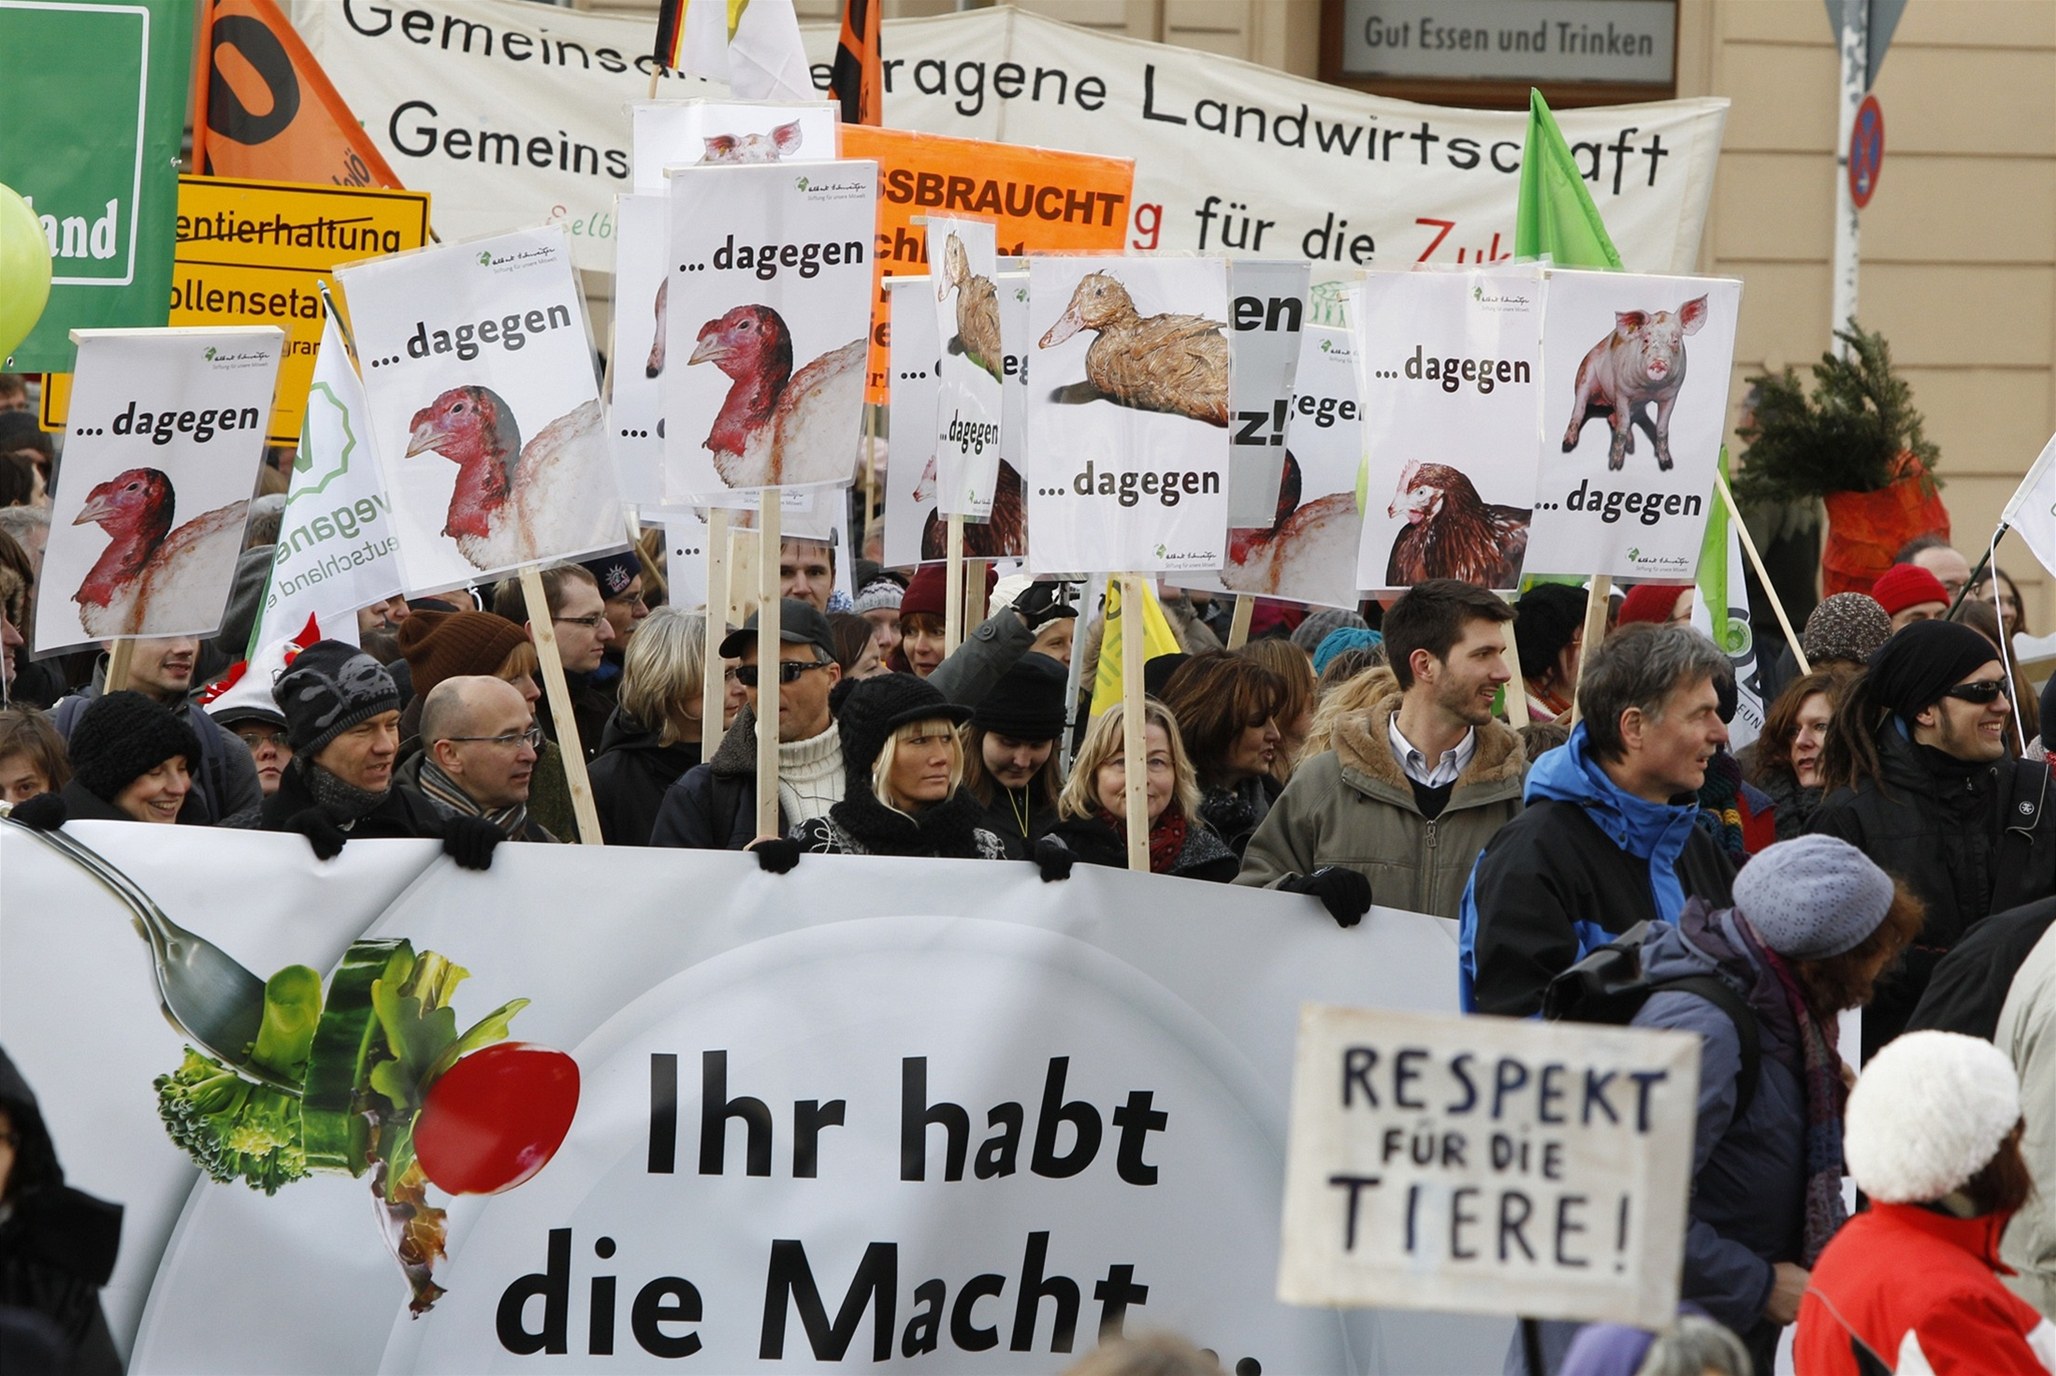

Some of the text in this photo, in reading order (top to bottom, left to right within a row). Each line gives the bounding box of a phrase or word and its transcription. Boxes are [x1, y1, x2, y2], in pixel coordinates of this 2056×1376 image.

[1364, 16, 1654, 56] Gut Essen und Trinken
[343, 0, 1669, 195] Gemeinsa eragene Landwirtscaft
[23, 196, 118, 259] and
[176, 210, 400, 253] entierhaltung
[1132, 203, 1163, 250] g
[1195, 196, 1276, 252] für
[1302, 212, 1375, 265] die
[713, 235, 864, 280] dagegen
[408, 306, 571, 361] dagegen
[1404, 346, 1531, 394] dagegen
[113, 401, 259, 445] dagegen
[948, 409, 999, 455] dagegen
[1230, 399, 1289, 446] z!
[1290, 393, 1366, 428] ege
[1074, 461, 1220, 508] dagegen
[1567, 479, 1702, 525] dagegen
[1342, 1046, 1670, 1134] RESPEKT
[647, 1050, 1169, 1186] Ihr habt
[1382, 1119, 1467, 1169] FÜR
[1328, 1175, 1631, 1273] TIERE!
[495, 1228, 704, 1360] die
